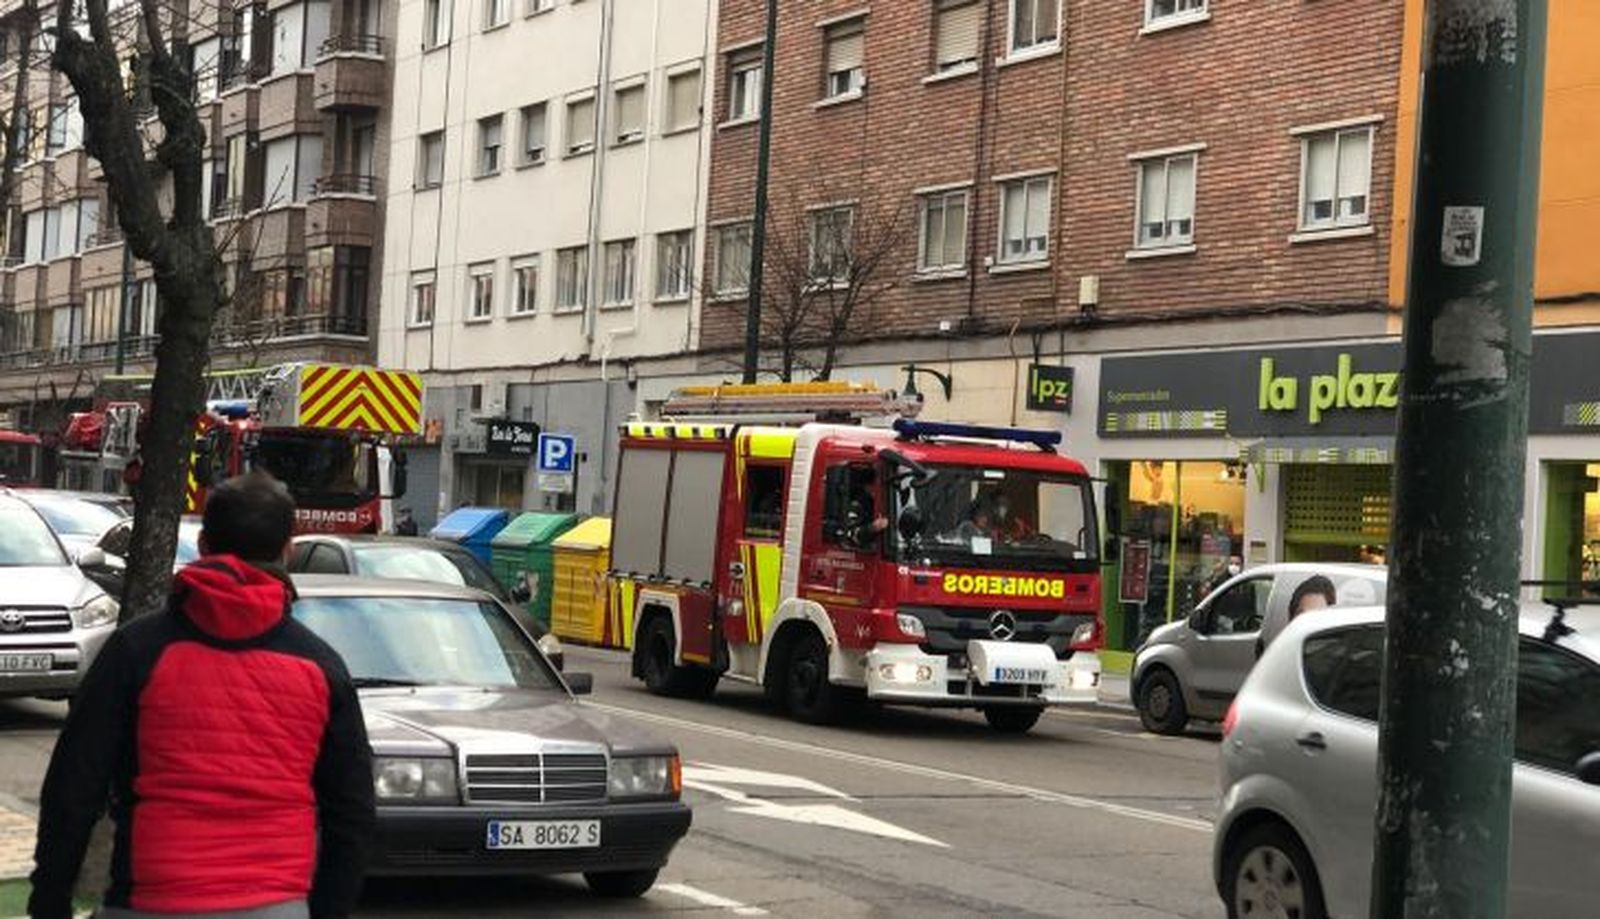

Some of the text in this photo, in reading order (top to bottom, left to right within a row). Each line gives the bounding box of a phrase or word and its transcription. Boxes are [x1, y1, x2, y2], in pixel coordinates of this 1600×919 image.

[1032, 368, 1069, 404] lpz
[1258, 353, 1399, 424] la plaz
[544, 438, 568, 468] P
[500, 823, 598, 846] SA 8062 S
